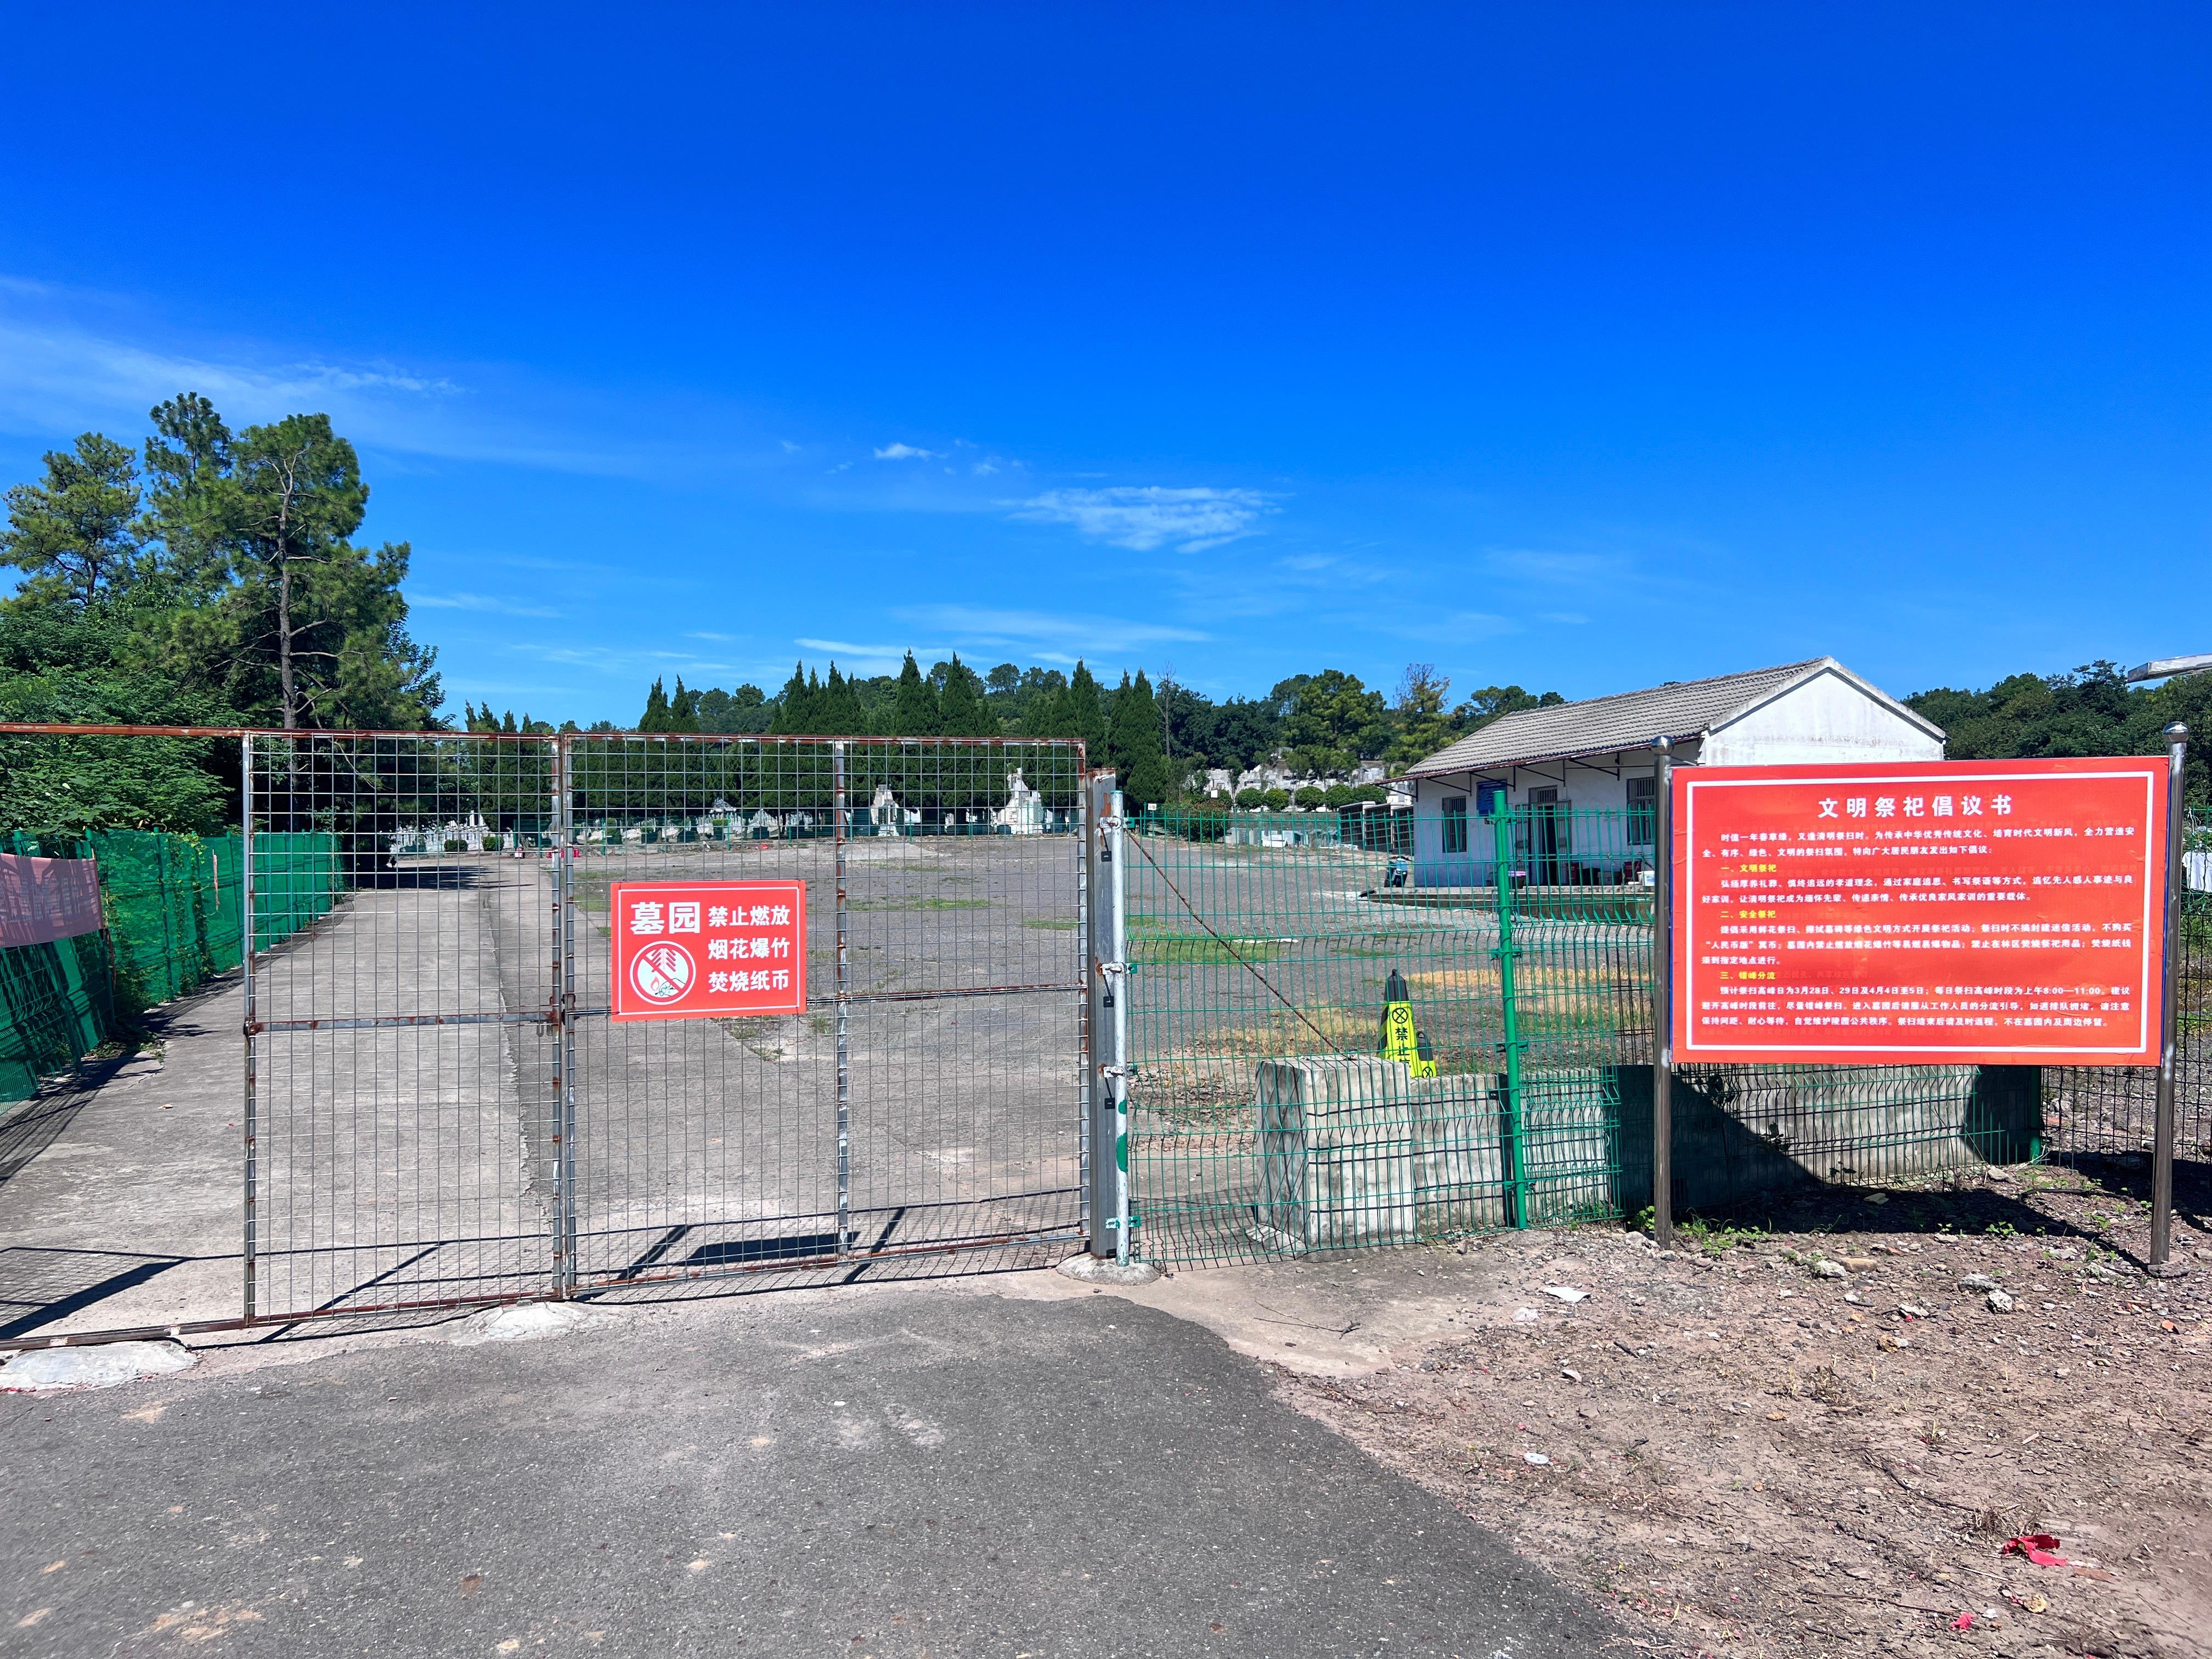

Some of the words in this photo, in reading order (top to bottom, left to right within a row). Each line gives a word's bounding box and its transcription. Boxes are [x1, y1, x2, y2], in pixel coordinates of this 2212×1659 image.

[1818, 794, 2011, 818] 文明祭祀倡议书
[1721, 864, 1776, 872] 一、文明祭祀
[630, 902, 700, 934] 墓园
[708, 905, 790, 927] 禁止燃放
[1721, 910, 1776, 918] 二、安全祭祀
[708, 937, 790, 960] 烟花爆竹
[708, 969, 789, 993] 焚烧纸币
